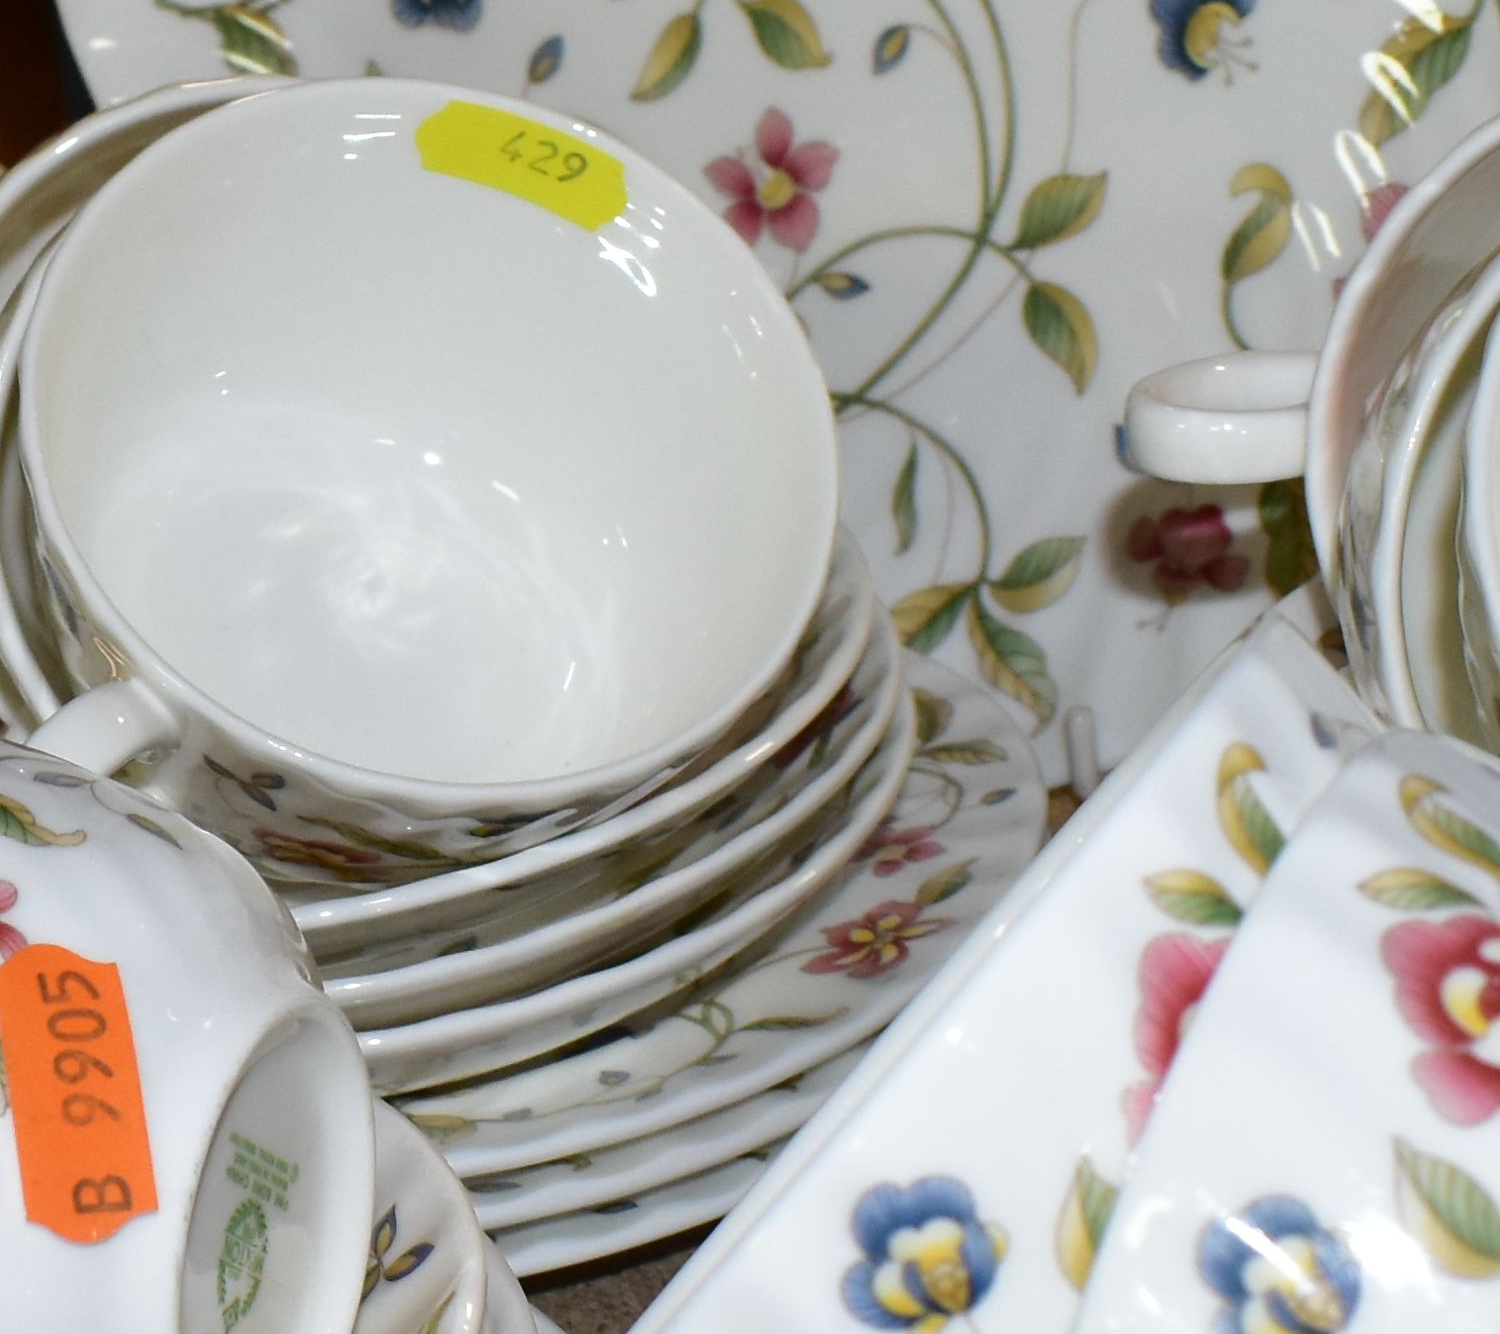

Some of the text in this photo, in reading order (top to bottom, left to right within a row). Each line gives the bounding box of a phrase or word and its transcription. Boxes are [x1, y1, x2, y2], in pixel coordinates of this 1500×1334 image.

[500, 131, 588, 182] 429
[36, 971, 133, 1215] B 9905
